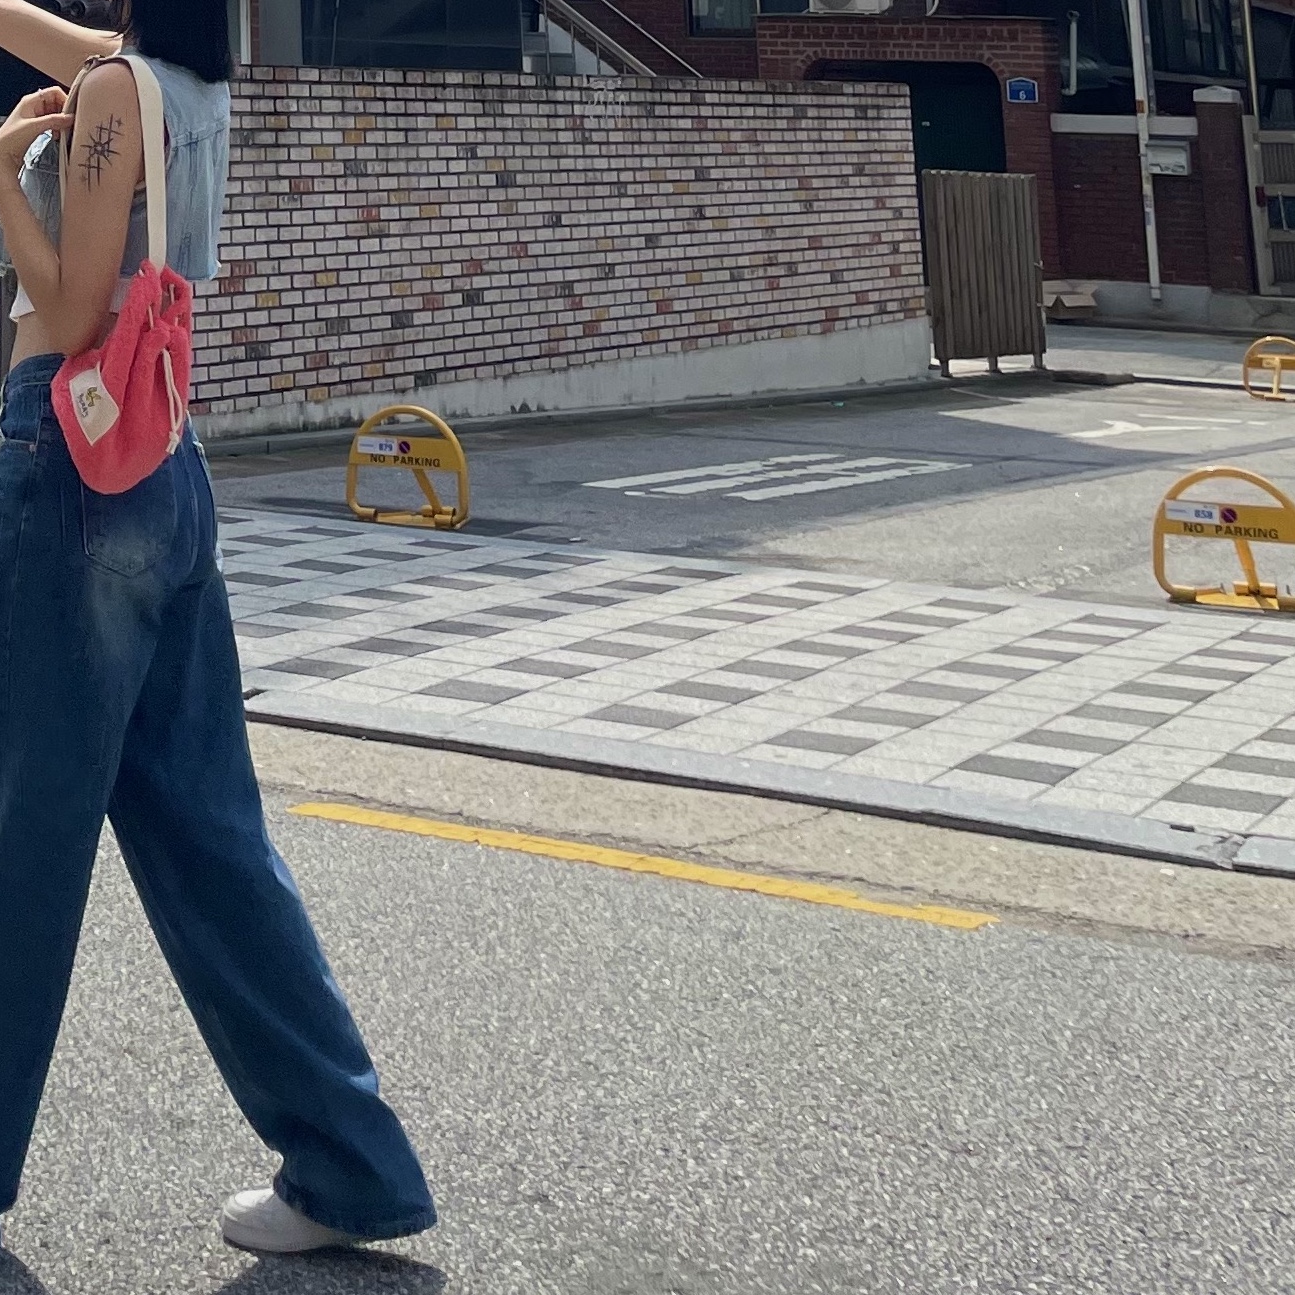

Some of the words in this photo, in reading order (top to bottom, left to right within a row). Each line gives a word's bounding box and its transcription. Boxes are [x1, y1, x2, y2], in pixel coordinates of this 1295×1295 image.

[370, 454, 386, 464] NO
[393, 455, 441, 468] PARKING
[1183, 523, 1205, 534] NO
[1215, 524, 1279, 540] PARKING
